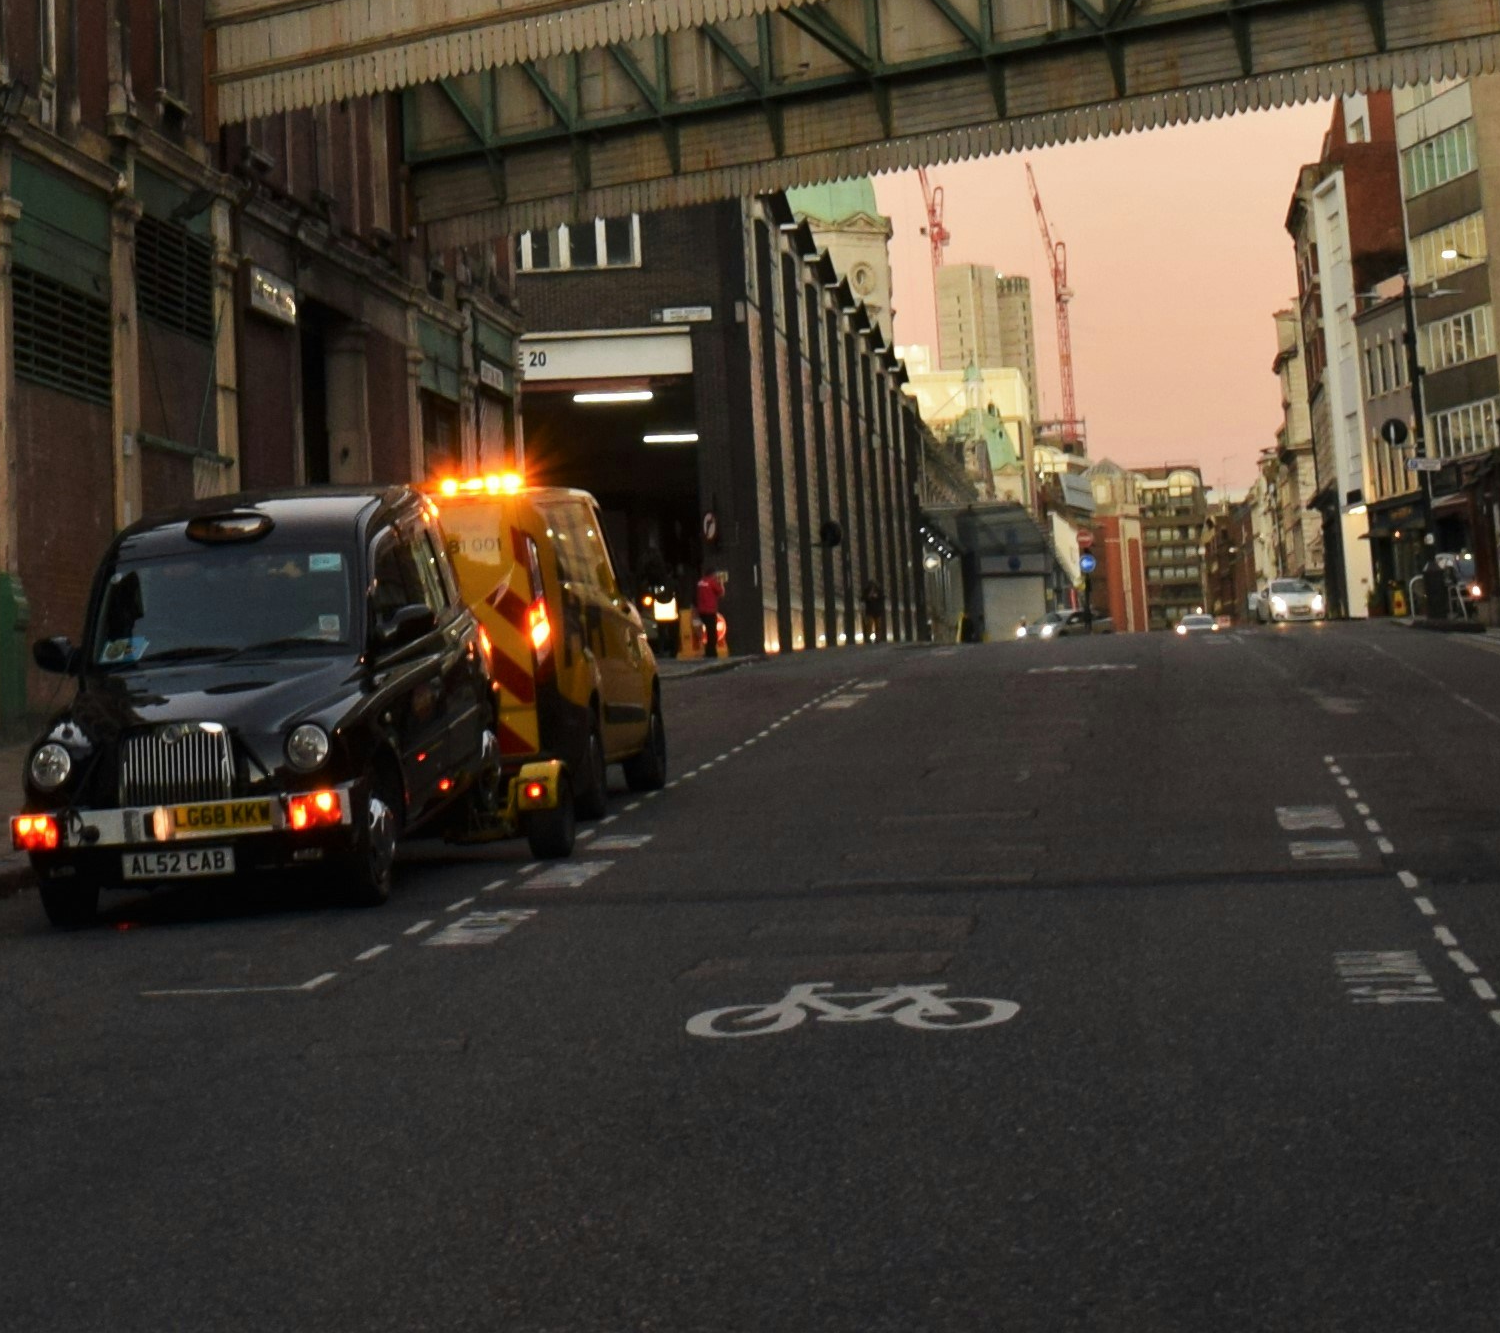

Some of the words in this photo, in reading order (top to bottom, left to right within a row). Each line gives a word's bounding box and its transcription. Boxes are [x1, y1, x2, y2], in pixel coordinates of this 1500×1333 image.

[529, 351, 547, 367] 20
[132, 854, 181, 875] AL52
[186, 850, 226, 872] CAB
